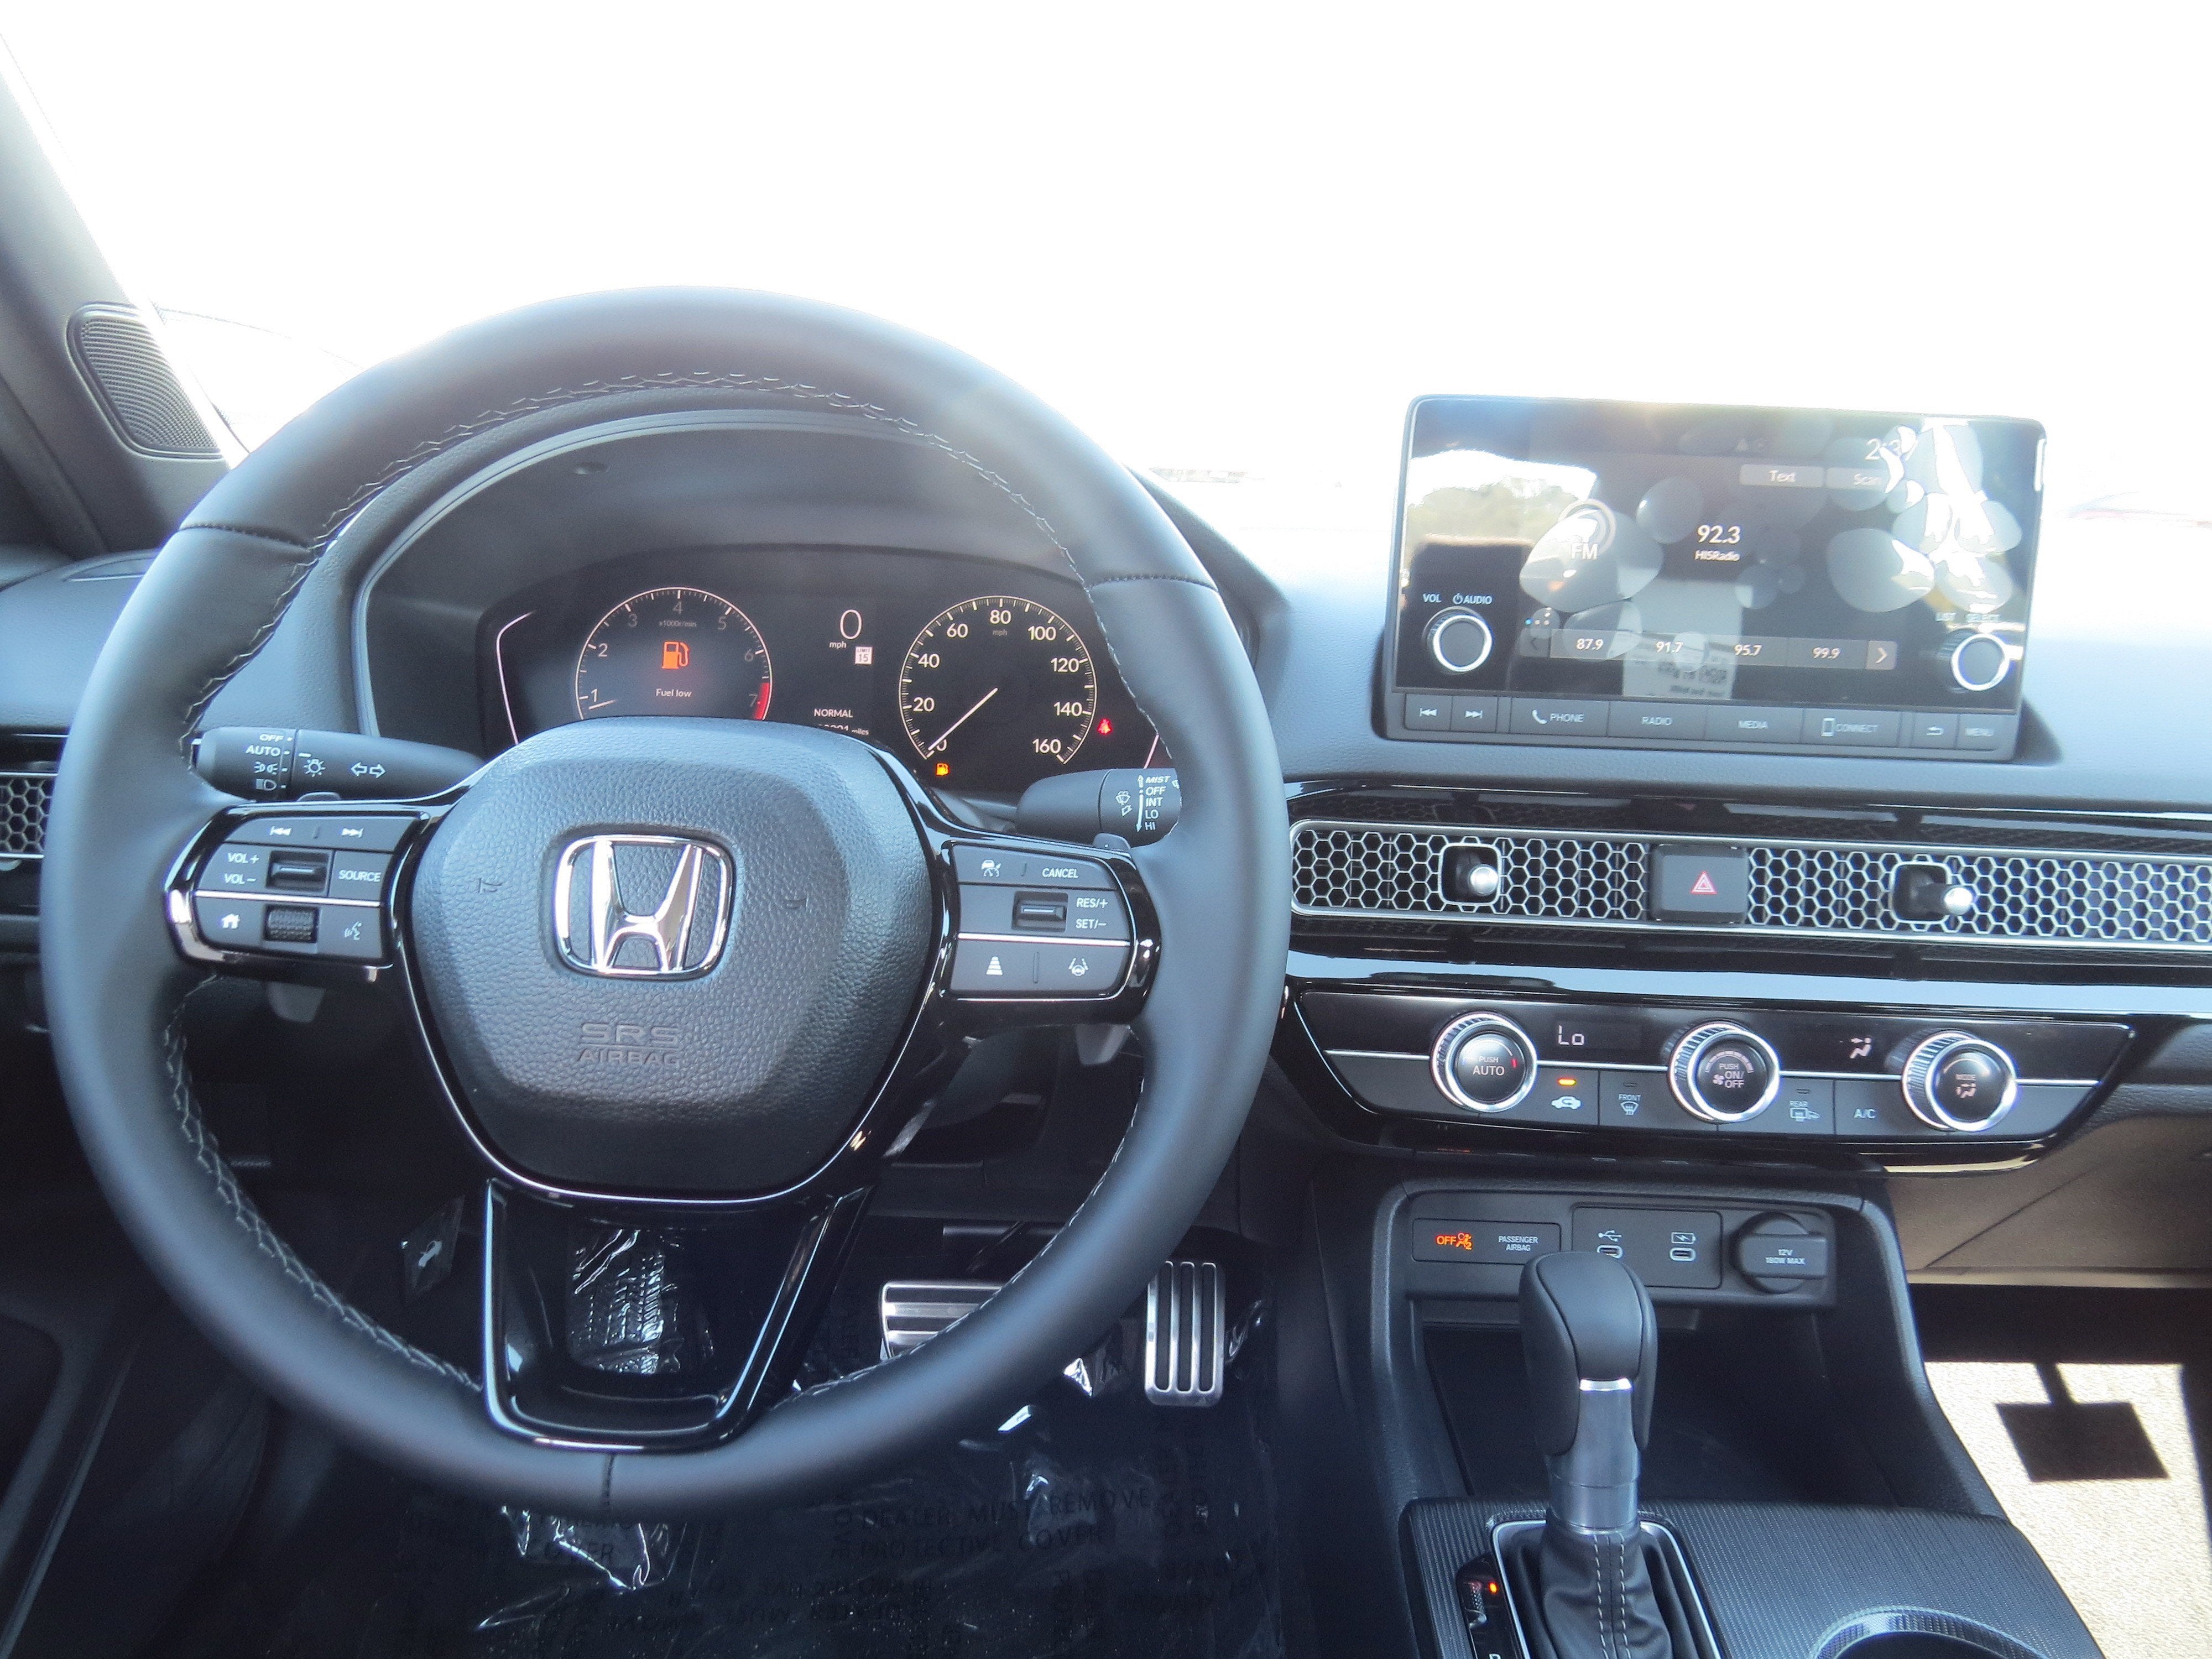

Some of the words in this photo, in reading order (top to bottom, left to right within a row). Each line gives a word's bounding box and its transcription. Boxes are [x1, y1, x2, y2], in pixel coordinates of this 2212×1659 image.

[1697, 524, 1741, 544] 92.3
[1571, 542, 1599, 560] FM
[1422, 593, 1442, 603] VOL
[1463, 594, 1493, 606] AUDIO
[672, 601, 683, 614] 4
[627, 613, 638, 628] 3
[717, 616, 727, 630] 5
[989, 609, 1011, 624] 80
[839, 609, 862, 640] 0
[946, 623, 969, 639] 60
[1027, 625, 1057, 641] 100
[597, 643, 608, 658] 2
[829, 640, 847, 649] mph
[1575, 638, 1604, 651] 87.9
[1656, 641, 1684, 654] 91.7
[1734, 644, 1762, 657] 95.7
[744, 648, 754, 661] 6
[859, 654, 869, 662] 15
[1812, 646, 1840, 660] 99.9
[918, 653, 940, 668] 40
[1051, 657, 1079, 673] 120
[591, 688, 598, 702] 1
[655, 688, 674, 697] Fuel
[675, 688, 692, 697] low
[748, 693, 758, 707] 7
[913, 697, 935, 712] 20
[813, 708, 853, 718] NORMAL
[1053, 701, 1083, 717] 140
[1550, 713, 1584, 723] PHONE
[1641, 716, 1672, 727] RADIO
[259, 733, 284, 742] OFF
[245, 745, 281, 757] AUTO
[1032, 738, 1062, 754] 160
[1145, 775, 1171, 784] MIST
[1145, 786, 1167, 796] OFF
[1145, 797, 1164, 807] INT
[1145, 809, 1159, 820] LO
[1144, 821, 1156, 831] HI
[338, 869, 382, 883] SOURCE
[1042, 867, 1079, 878] CANCEL
[1076, 897, 1108, 909] RES/+
[580, 1022, 679, 1046] SRS
[1558, 1024, 1585, 1046] Lo
[577, 1047, 679, 1065] AIRBAG
[1472, 1065, 1505, 1076] AUTO
[1724, 1071, 1744, 1079] ON/
[1724, 1079, 1744, 1088] OFF
[1854, 1108, 1876, 1119] A/C
[1436, 1235, 1457, 1245] OFF
[1498, 1235, 1538, 1244] PASSENGER
